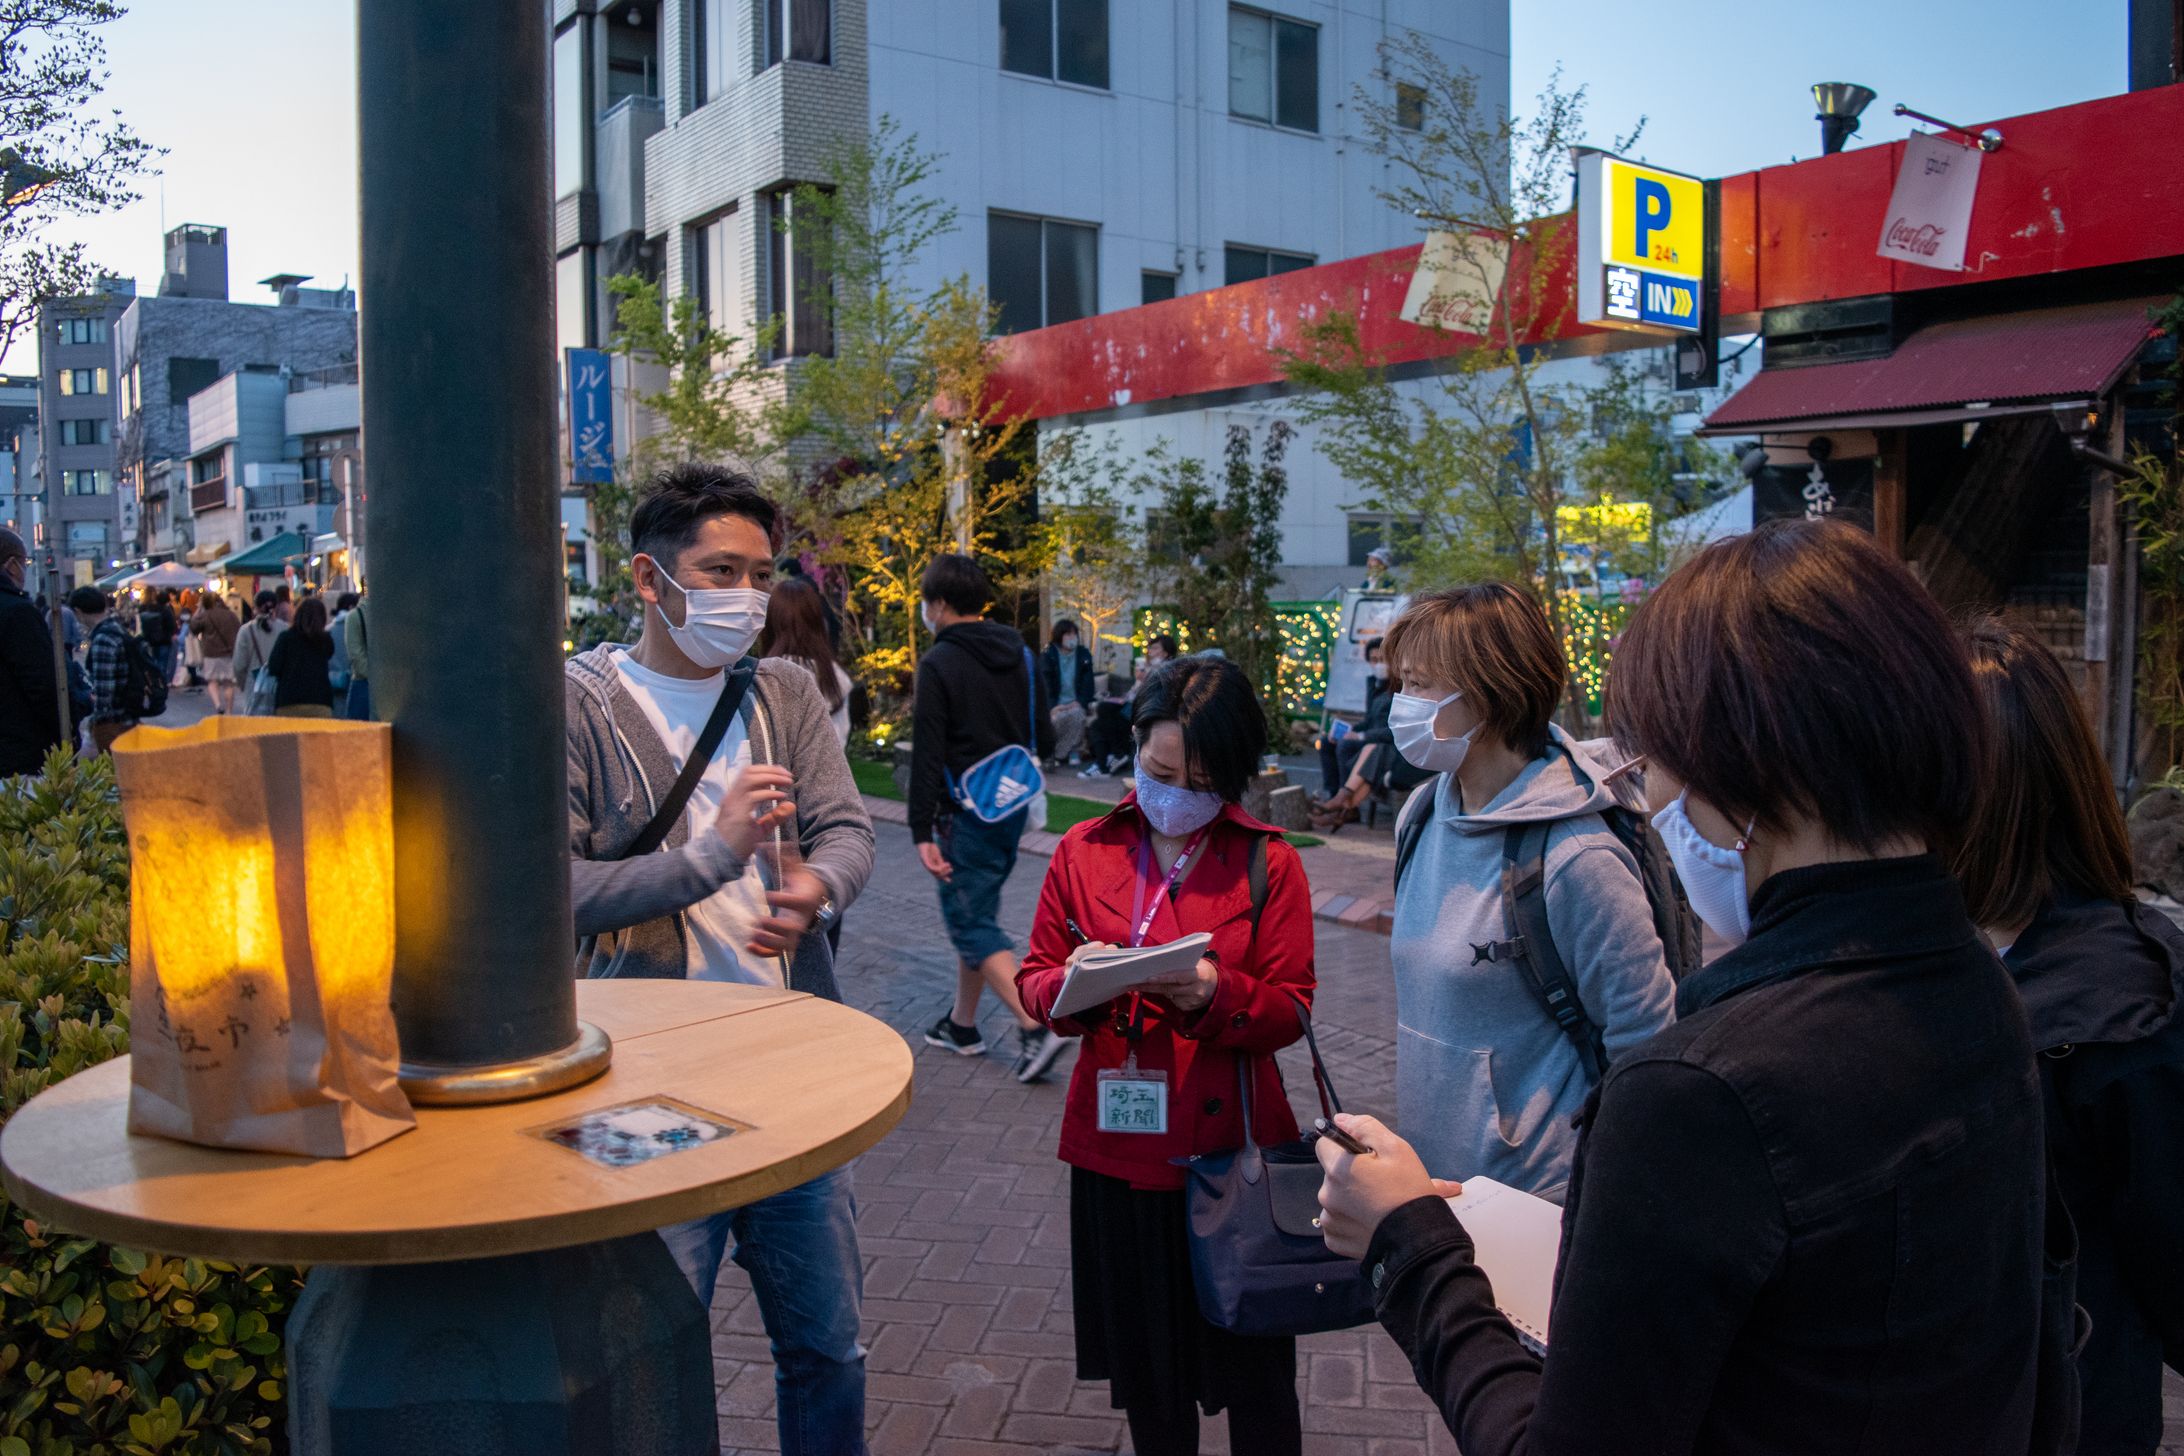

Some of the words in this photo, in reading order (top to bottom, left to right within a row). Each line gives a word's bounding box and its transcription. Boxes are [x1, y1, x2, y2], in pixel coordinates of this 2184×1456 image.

[1635, 177, 1672, 258] P
[1654, 244, 1679, 264] 24h
[1607, 267, 1640, 319] 空
[1647, 282, 1672, 315] IN
[1110, 1107, 1155, 1126] 新聞
